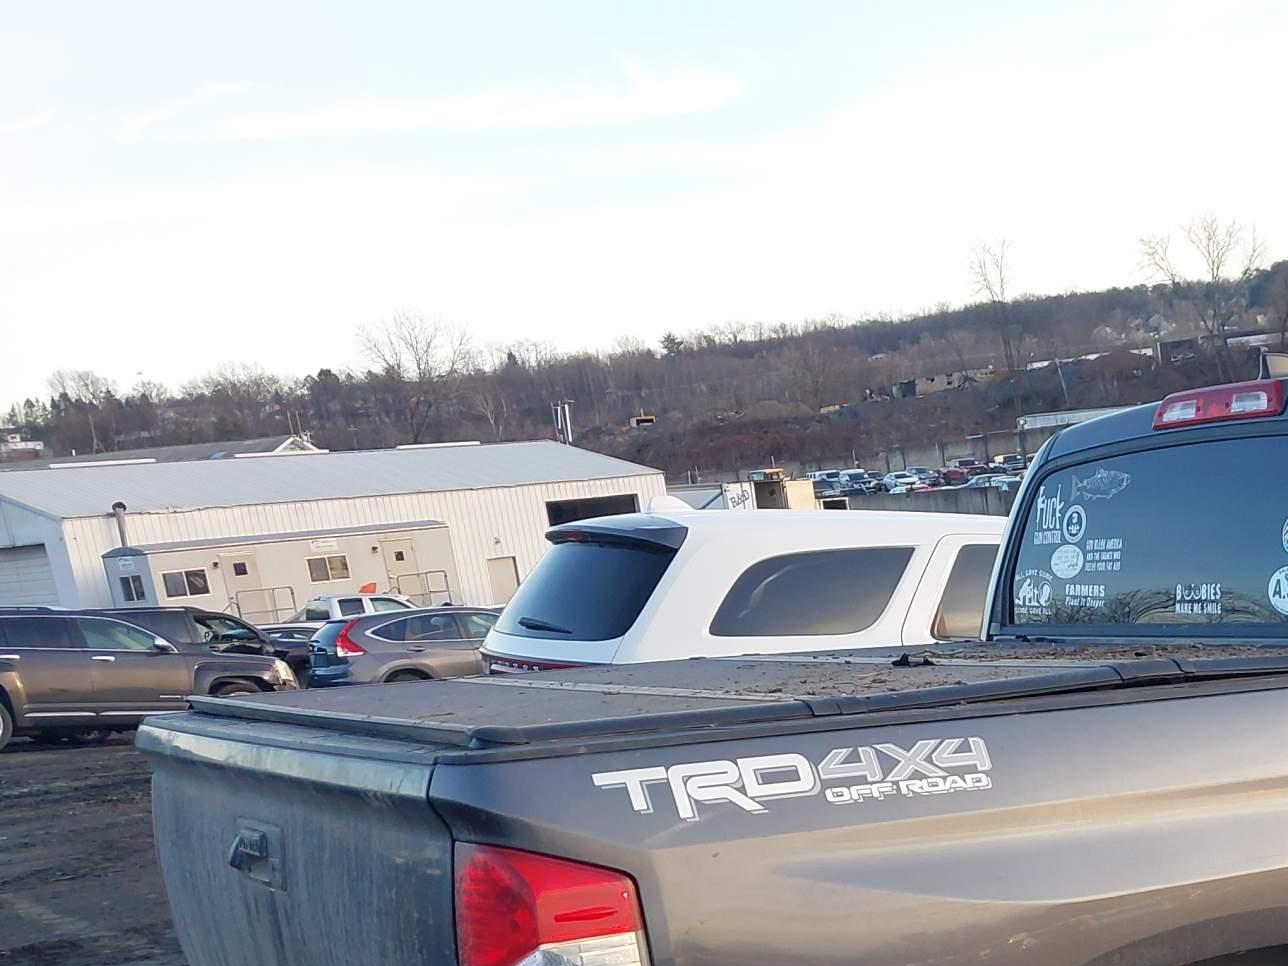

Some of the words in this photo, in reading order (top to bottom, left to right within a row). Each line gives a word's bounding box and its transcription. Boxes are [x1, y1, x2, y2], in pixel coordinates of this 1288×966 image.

[1065, 583, 1105, 597] FARMERS
[1065, 596, 1080, 606] Plant
[1176, 602, 1192, 614] MAKE
[1193, 602, 1202, 614] ME
[1203, 602, 1222, 615] SMILE
[591, 752, 818, 822] TRD
[817, 736, 992, 782] 4X4
[824, 781, 897, 804] OFF
[899, 773, 992, 797] ROAD
